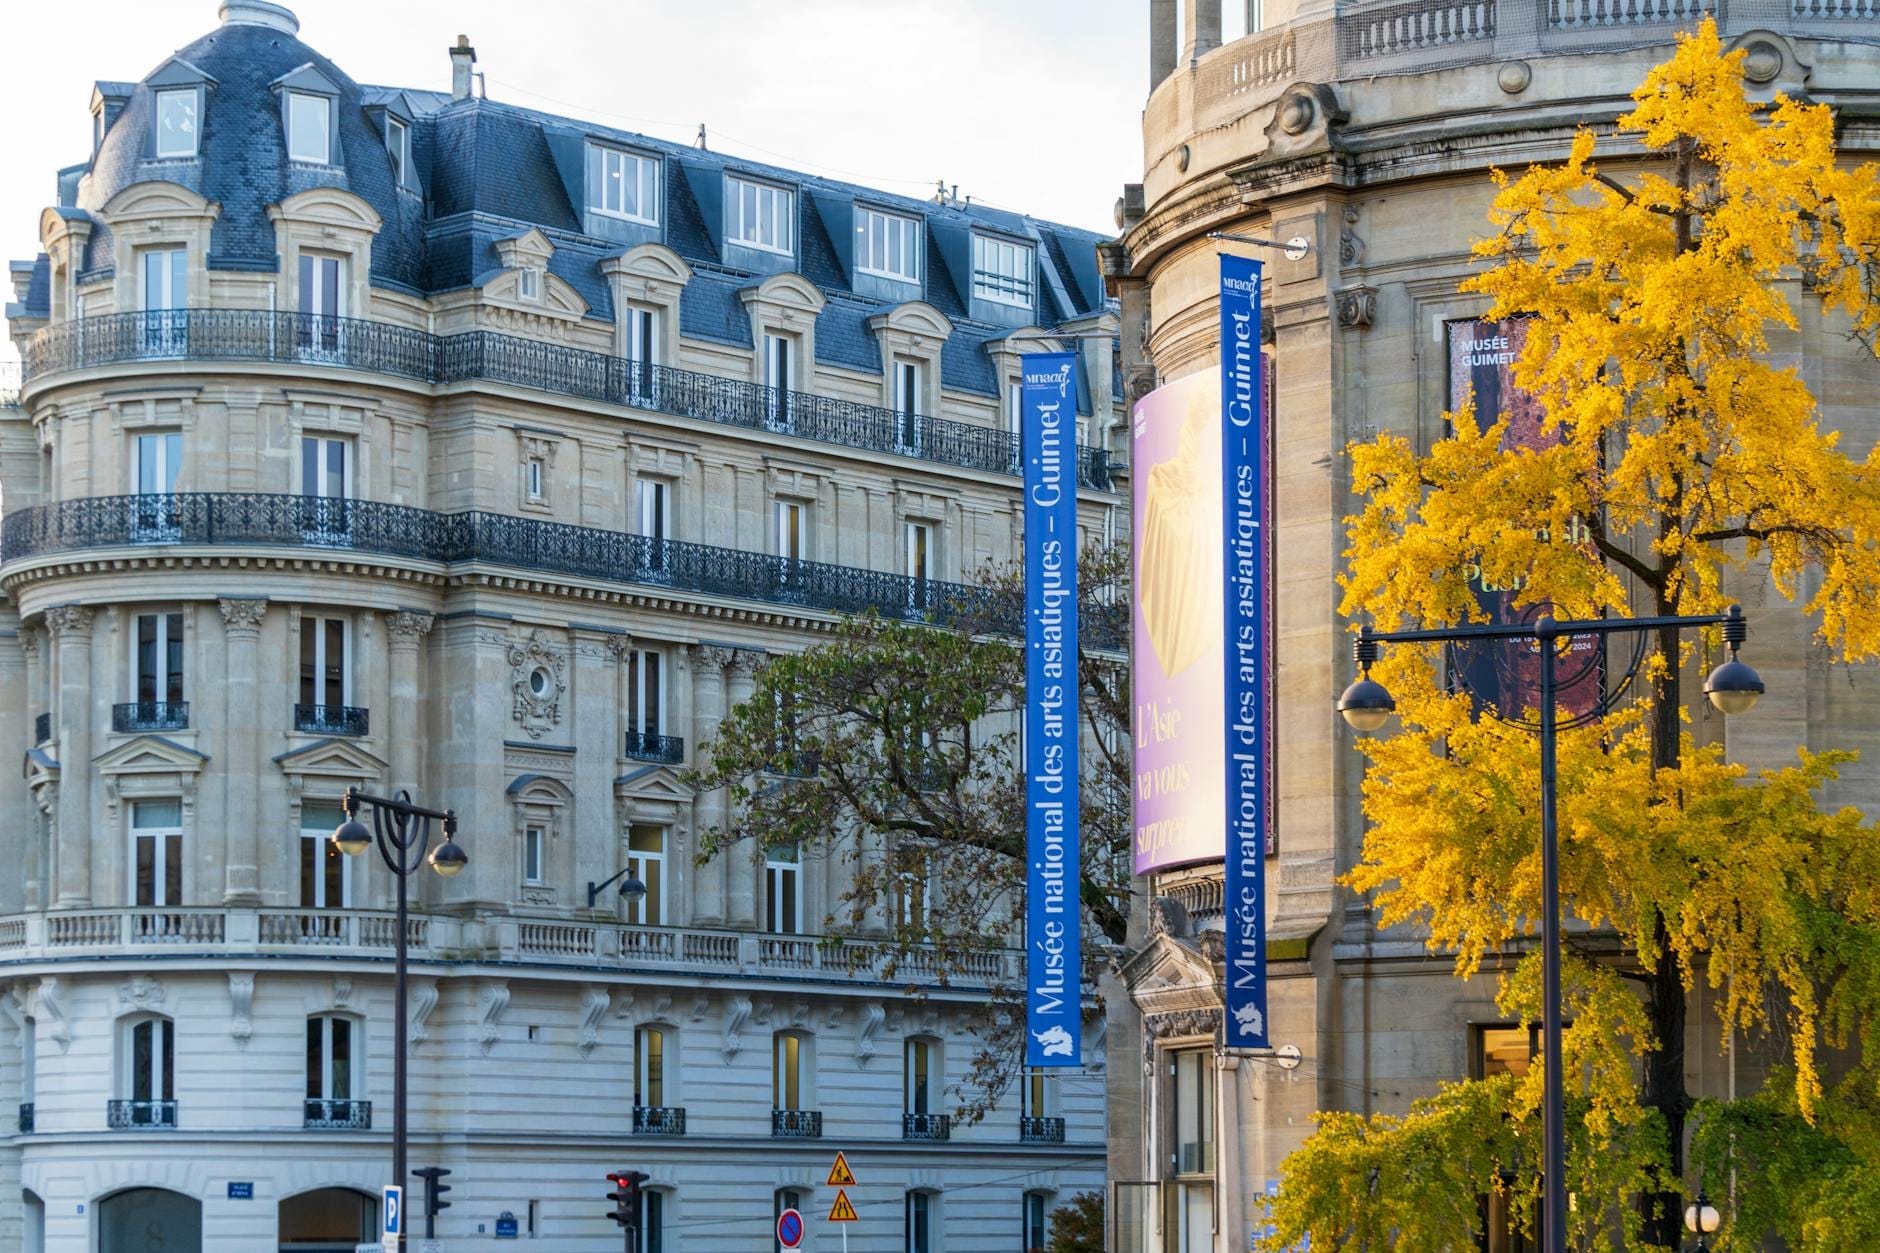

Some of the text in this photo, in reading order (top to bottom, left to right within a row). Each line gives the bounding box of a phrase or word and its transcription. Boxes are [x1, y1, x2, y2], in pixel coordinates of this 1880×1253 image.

[1228, 309, 1250, 427] Guimet
[1461, 336, 1509, 351] MUSÉE
[1461, 352, 1516, 367] GUIMET
[1032, 400, 1060, 507] Guimet
[1231, 465, 1259, 617] asiatiques
[1033, 540, 1069, 678] asiatiques
[1236, 625, 1254, 683] arts
[1572, 642, 1592, 651] 2024
[1039, 685, 1062, 738] arts
[1137, 696, 1181, 749] L'Asie
[1233, 691, 1254, 744] des
[1035, 744, 1062, 794] des
[1137, 760, 1192, 801] va vous
[1233, 753, 1255, 877] national
[1035, 802, 1062, 913] national
[1234, 886, 1255, 989] Musée
[1036, 921, 1063, 1014] Musée
[387, 1197, 397, 1227] P
